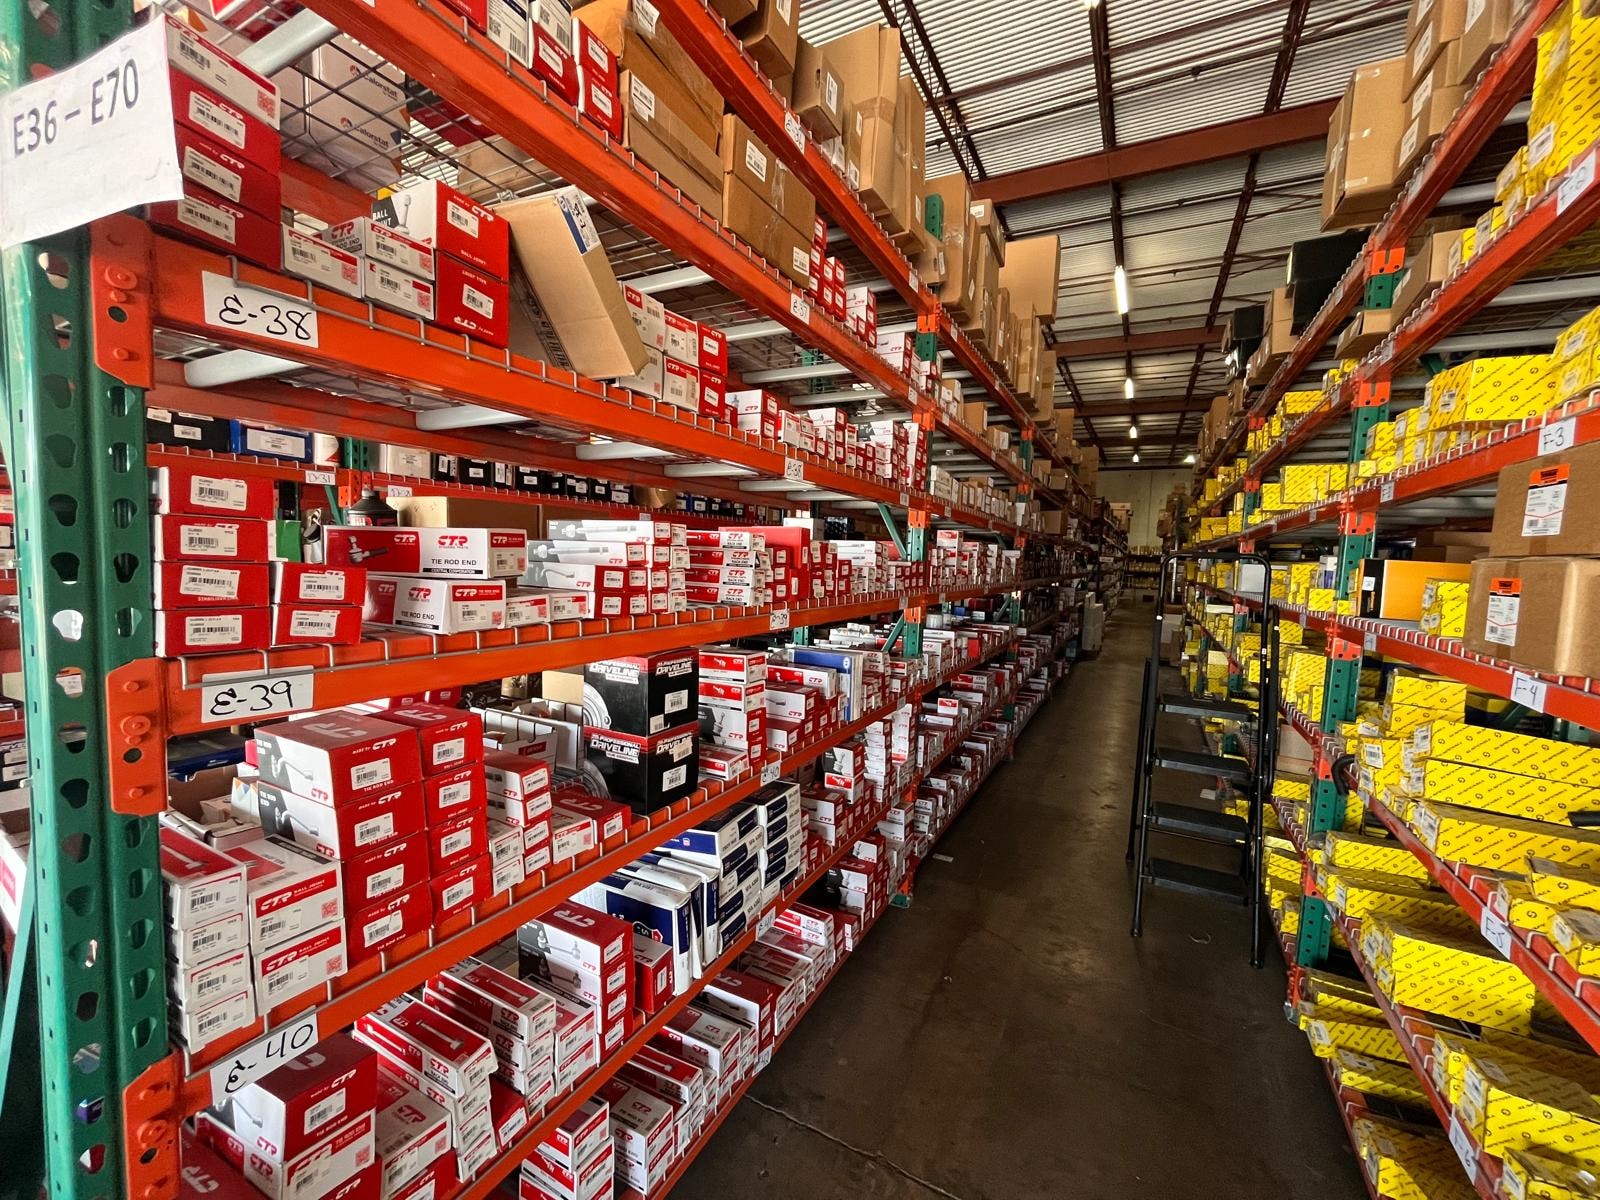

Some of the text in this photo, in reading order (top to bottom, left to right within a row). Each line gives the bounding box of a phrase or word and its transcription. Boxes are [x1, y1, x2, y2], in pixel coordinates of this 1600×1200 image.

[219, 293, 312, 340] E-38
[1543, 427, 1564, 450] F-3
[401, 611, 435, 621] TIE ROD END
[588, 663, 640, 677] DRIVELINE
[655, 661, 693, 677] DRIVELINE
[209, 680, 294, 716] E-39
[1515, 678, 1539, 706] F-4
[590, 739, 640, 757] DRIVELINE
